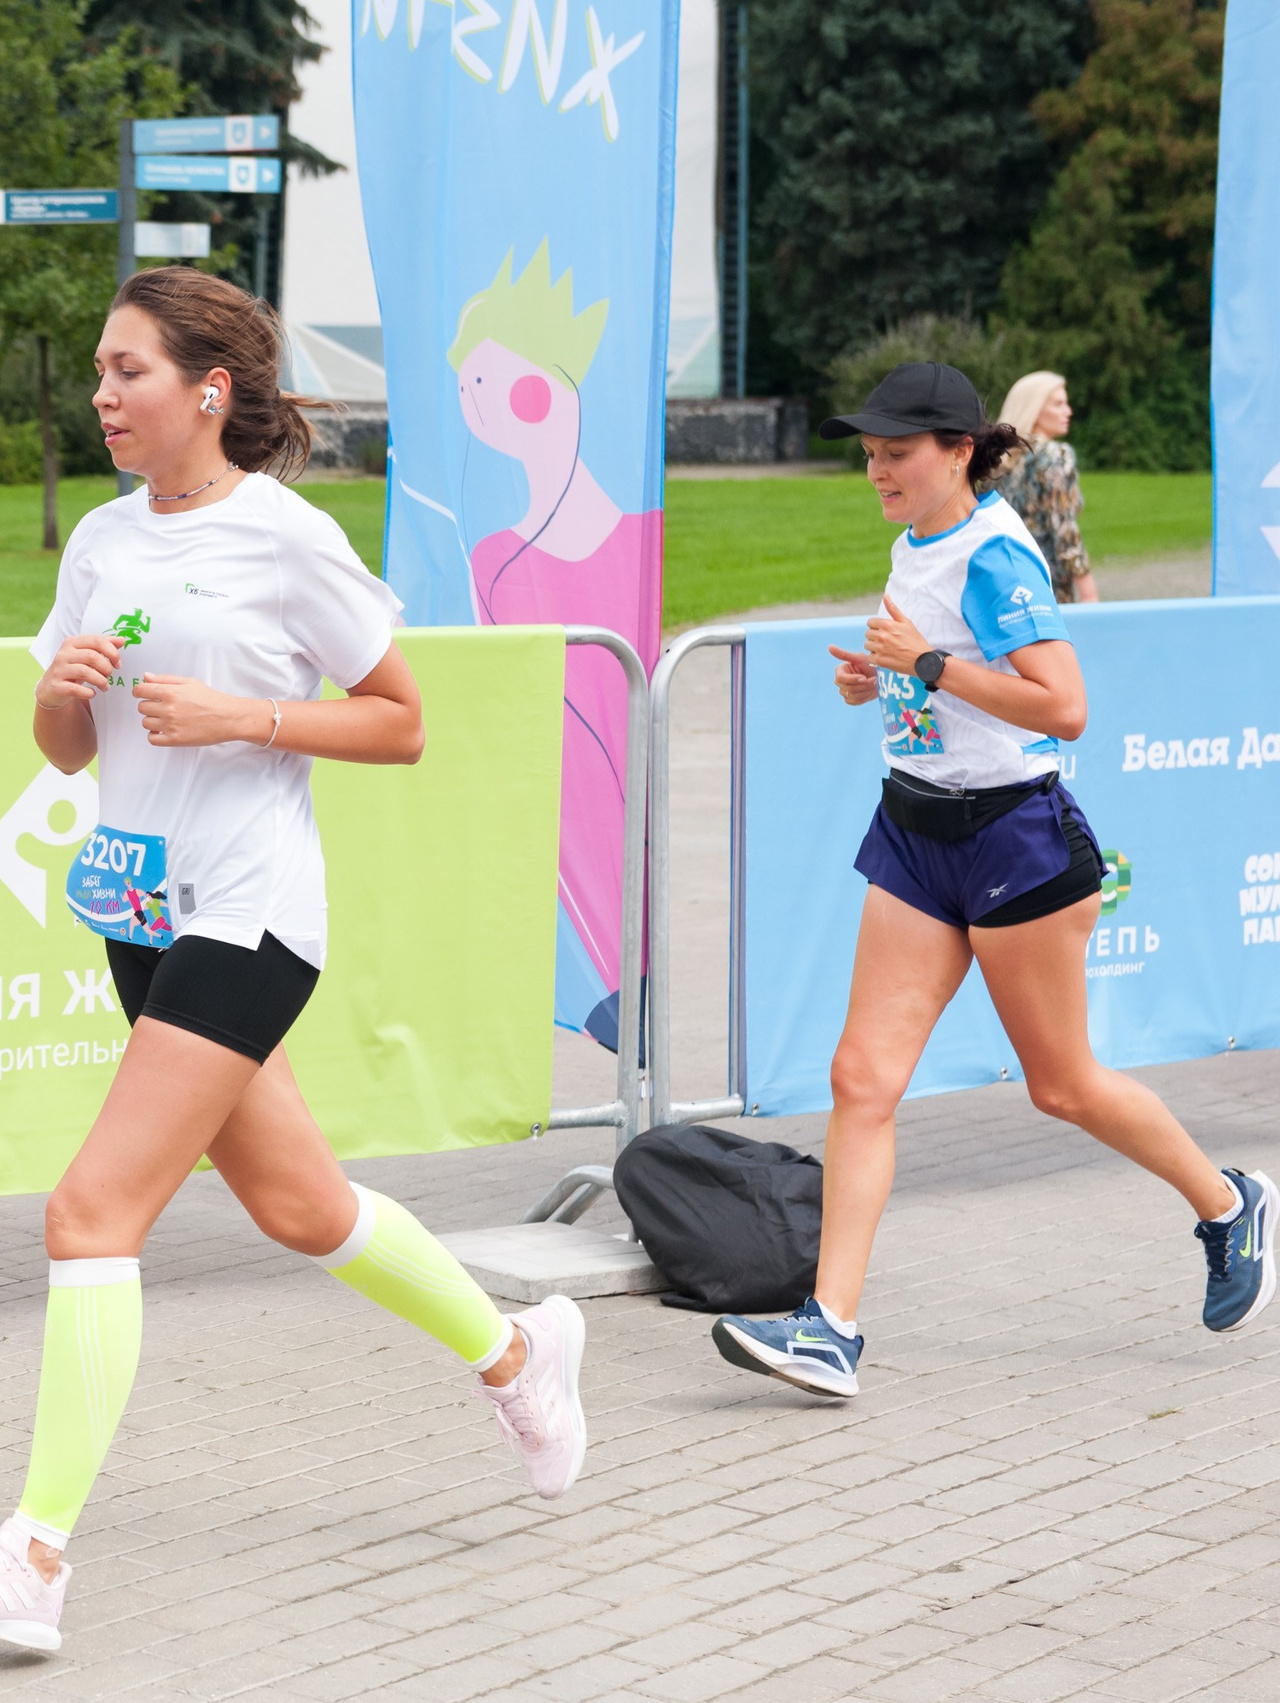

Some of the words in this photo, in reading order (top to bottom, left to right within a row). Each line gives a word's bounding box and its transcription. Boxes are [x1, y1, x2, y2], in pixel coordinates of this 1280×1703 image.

[1122, 733, 1231, 773] Белая
[80, 832, 147, 877] 3207
[90, 900, 103, 915] 10
[105, 900, 121, 915] КМ
